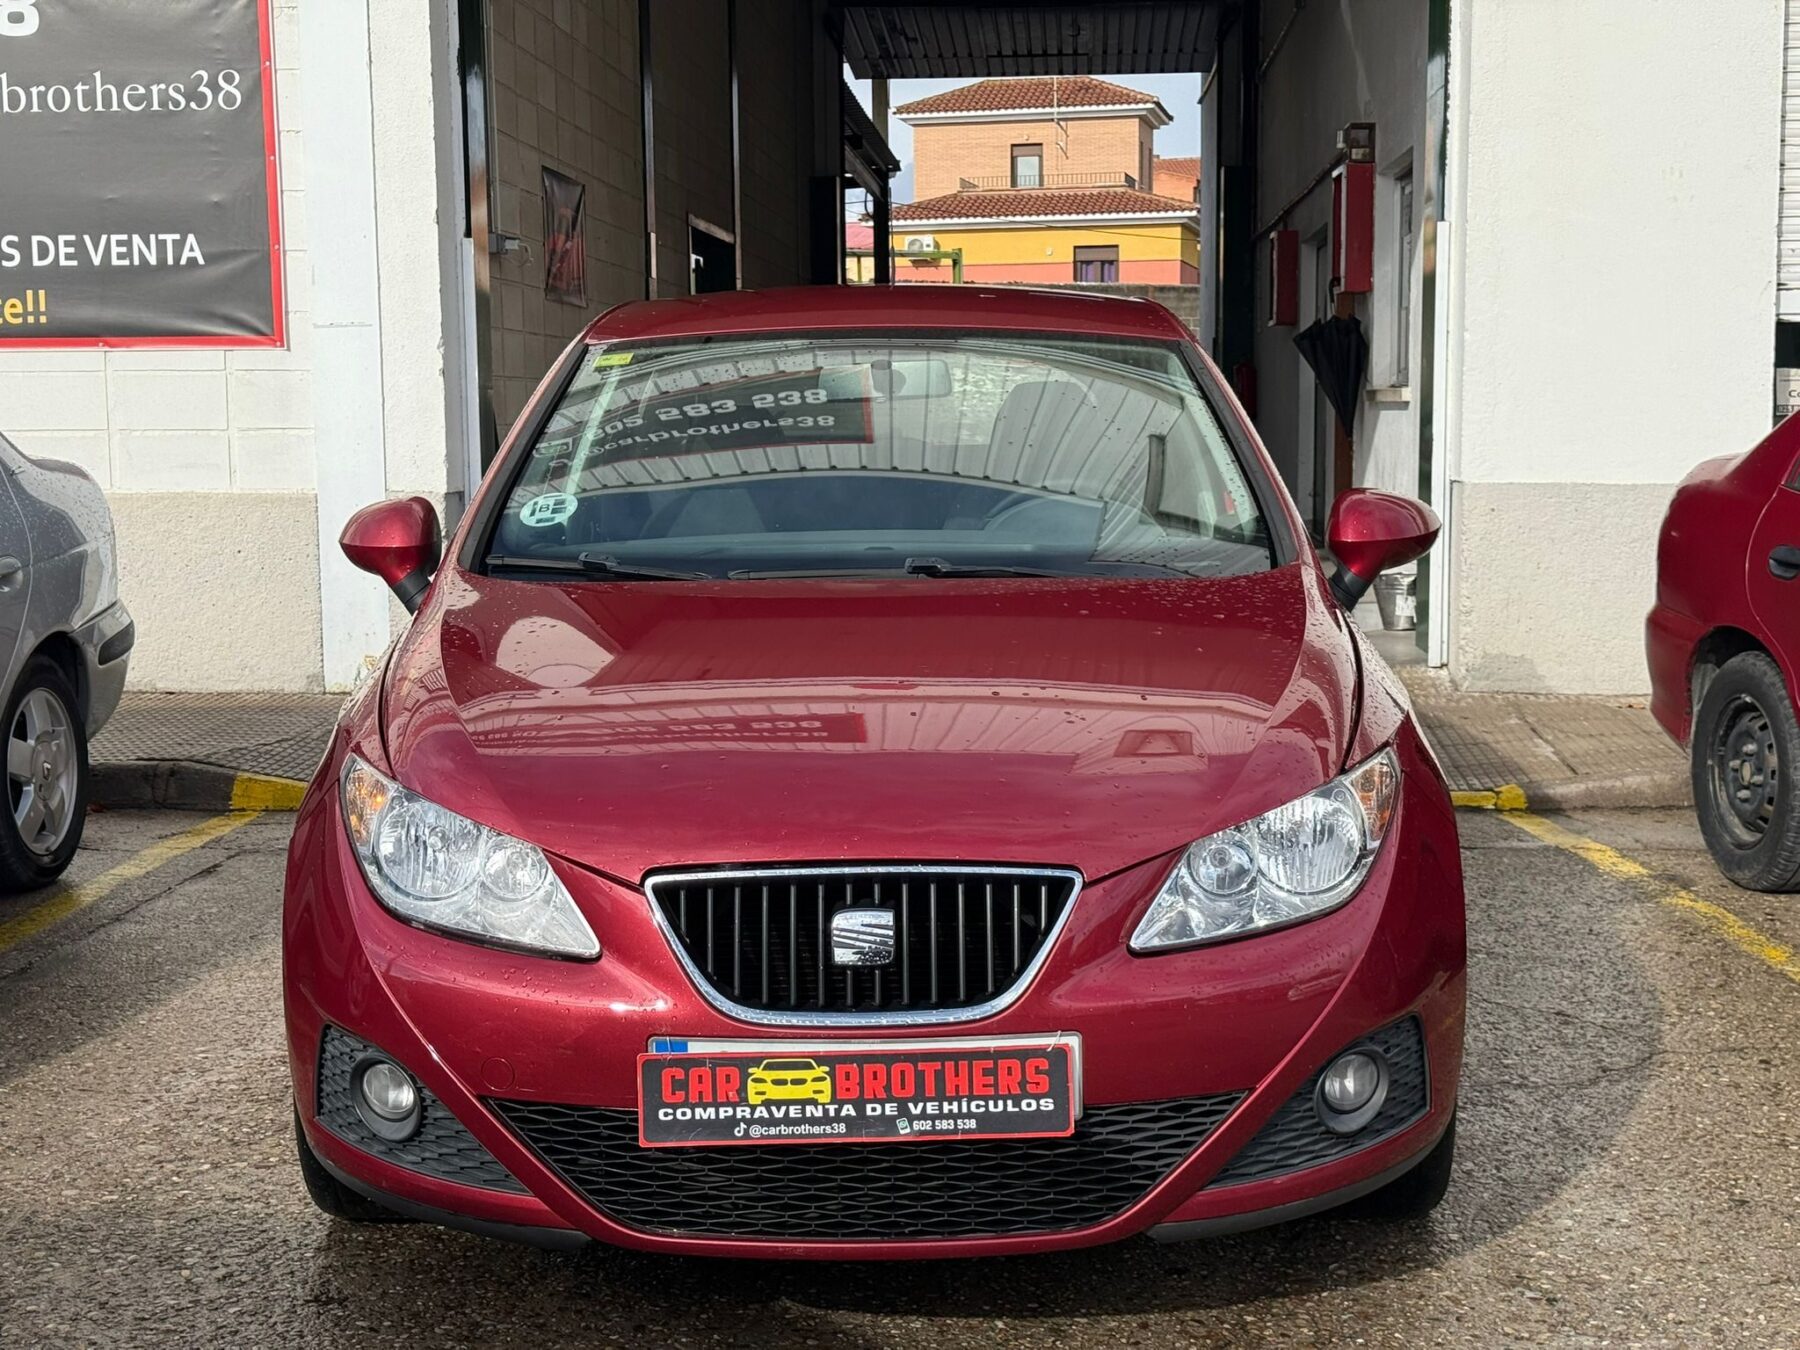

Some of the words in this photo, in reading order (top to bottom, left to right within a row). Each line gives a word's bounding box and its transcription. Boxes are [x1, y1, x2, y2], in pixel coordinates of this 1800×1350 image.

[31, 235, 78, 267] DE
[83, 233, 205, 266] VENTA
[661, 1065, 740, 1103] CAR
[836, 1058, 1050, 1100] BROTHERS
[658, 1104, 855, 1120] COMPRAVENTA
[866, 1103, 899, 1116] DE
[908, 1097, 1055, 1115] VEHÍCULOS
[749, 1122, 847, 1136] @carbrothers38
[912, 1120, 933, 1131] 602
[935, 1119, 955, 1130] 583
[957, 1118, 976, 1130] 538
